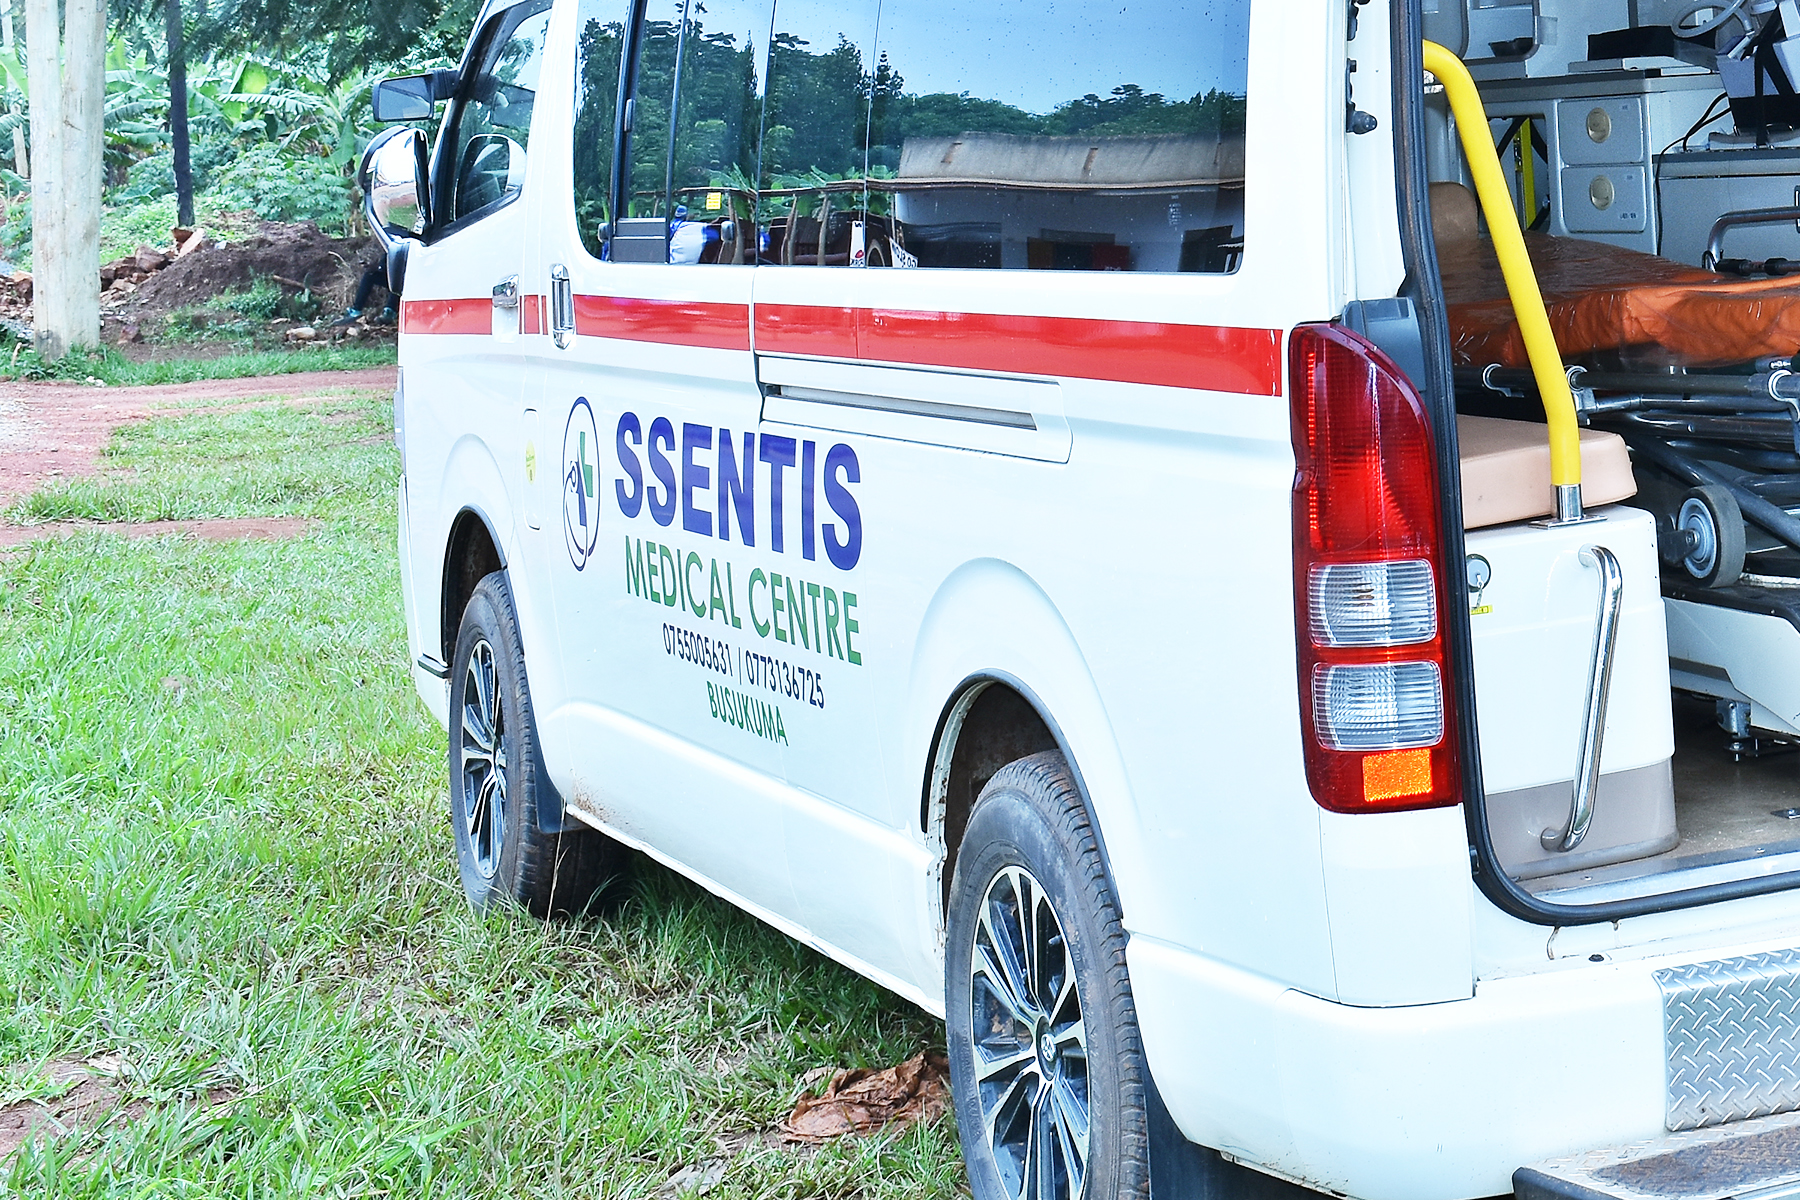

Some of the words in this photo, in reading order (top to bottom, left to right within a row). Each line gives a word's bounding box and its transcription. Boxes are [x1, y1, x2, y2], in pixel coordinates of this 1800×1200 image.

[615, 411, 862, 571] SSENTIS
[625, 535, 742, 630] MEDICAL
[748, 567, 862, 666] CENTRE
[663, 622, 733, 677] 0755005631
[745, 650, 825, 709] 0773136725
[707, 680, 789, 746] BUSUKUMA
